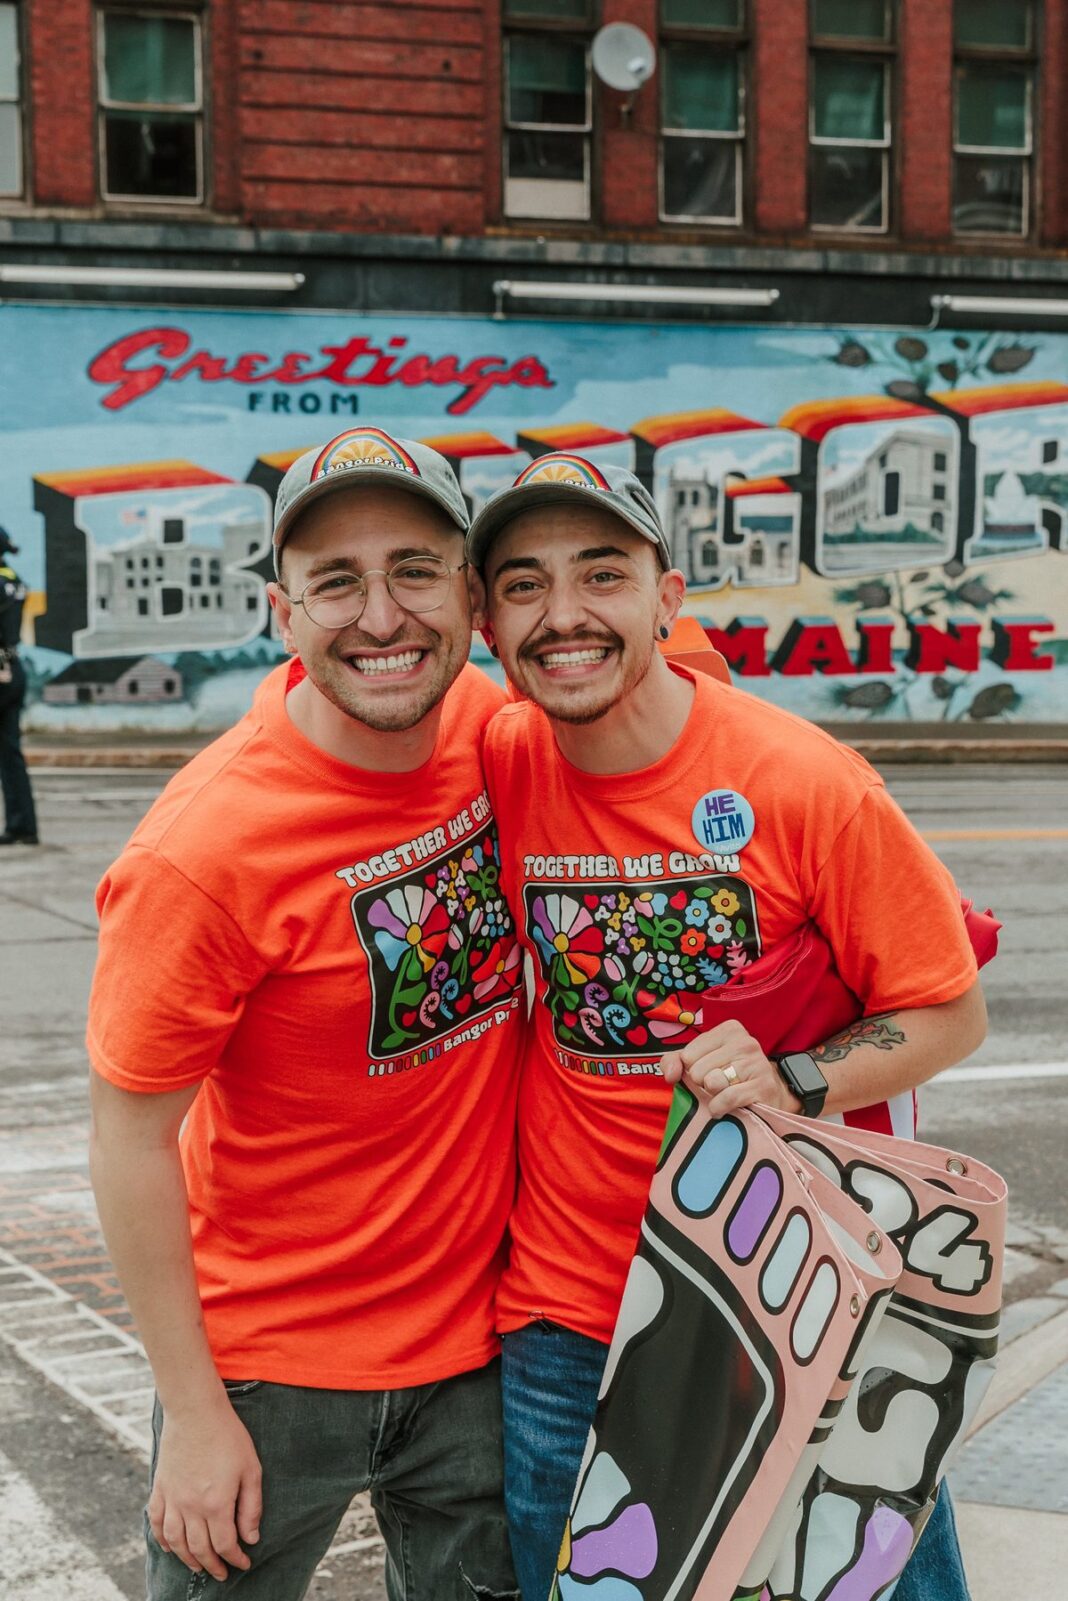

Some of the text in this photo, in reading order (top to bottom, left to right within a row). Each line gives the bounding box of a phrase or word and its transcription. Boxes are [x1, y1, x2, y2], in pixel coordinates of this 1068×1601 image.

[87, 326, 556, 414] Greetings
[248, 391, 360, 415] FROM
[316, 456, 415, 479] Bangor Pride
[33, 381, 1068, 658] BGOR
[703, 614, 1056, 678] MAINE
[704, 793, 736, 817] HE
[335, 789, 491, 888] TOGETHER WE GR
[702, 812, 746, 845] HIM
[522, 851, 741, 879] TOGETHER WE GROW
[443, 997, 519, 1053] Bangor Pre
[616, 1061, 665, 1076] Bang
